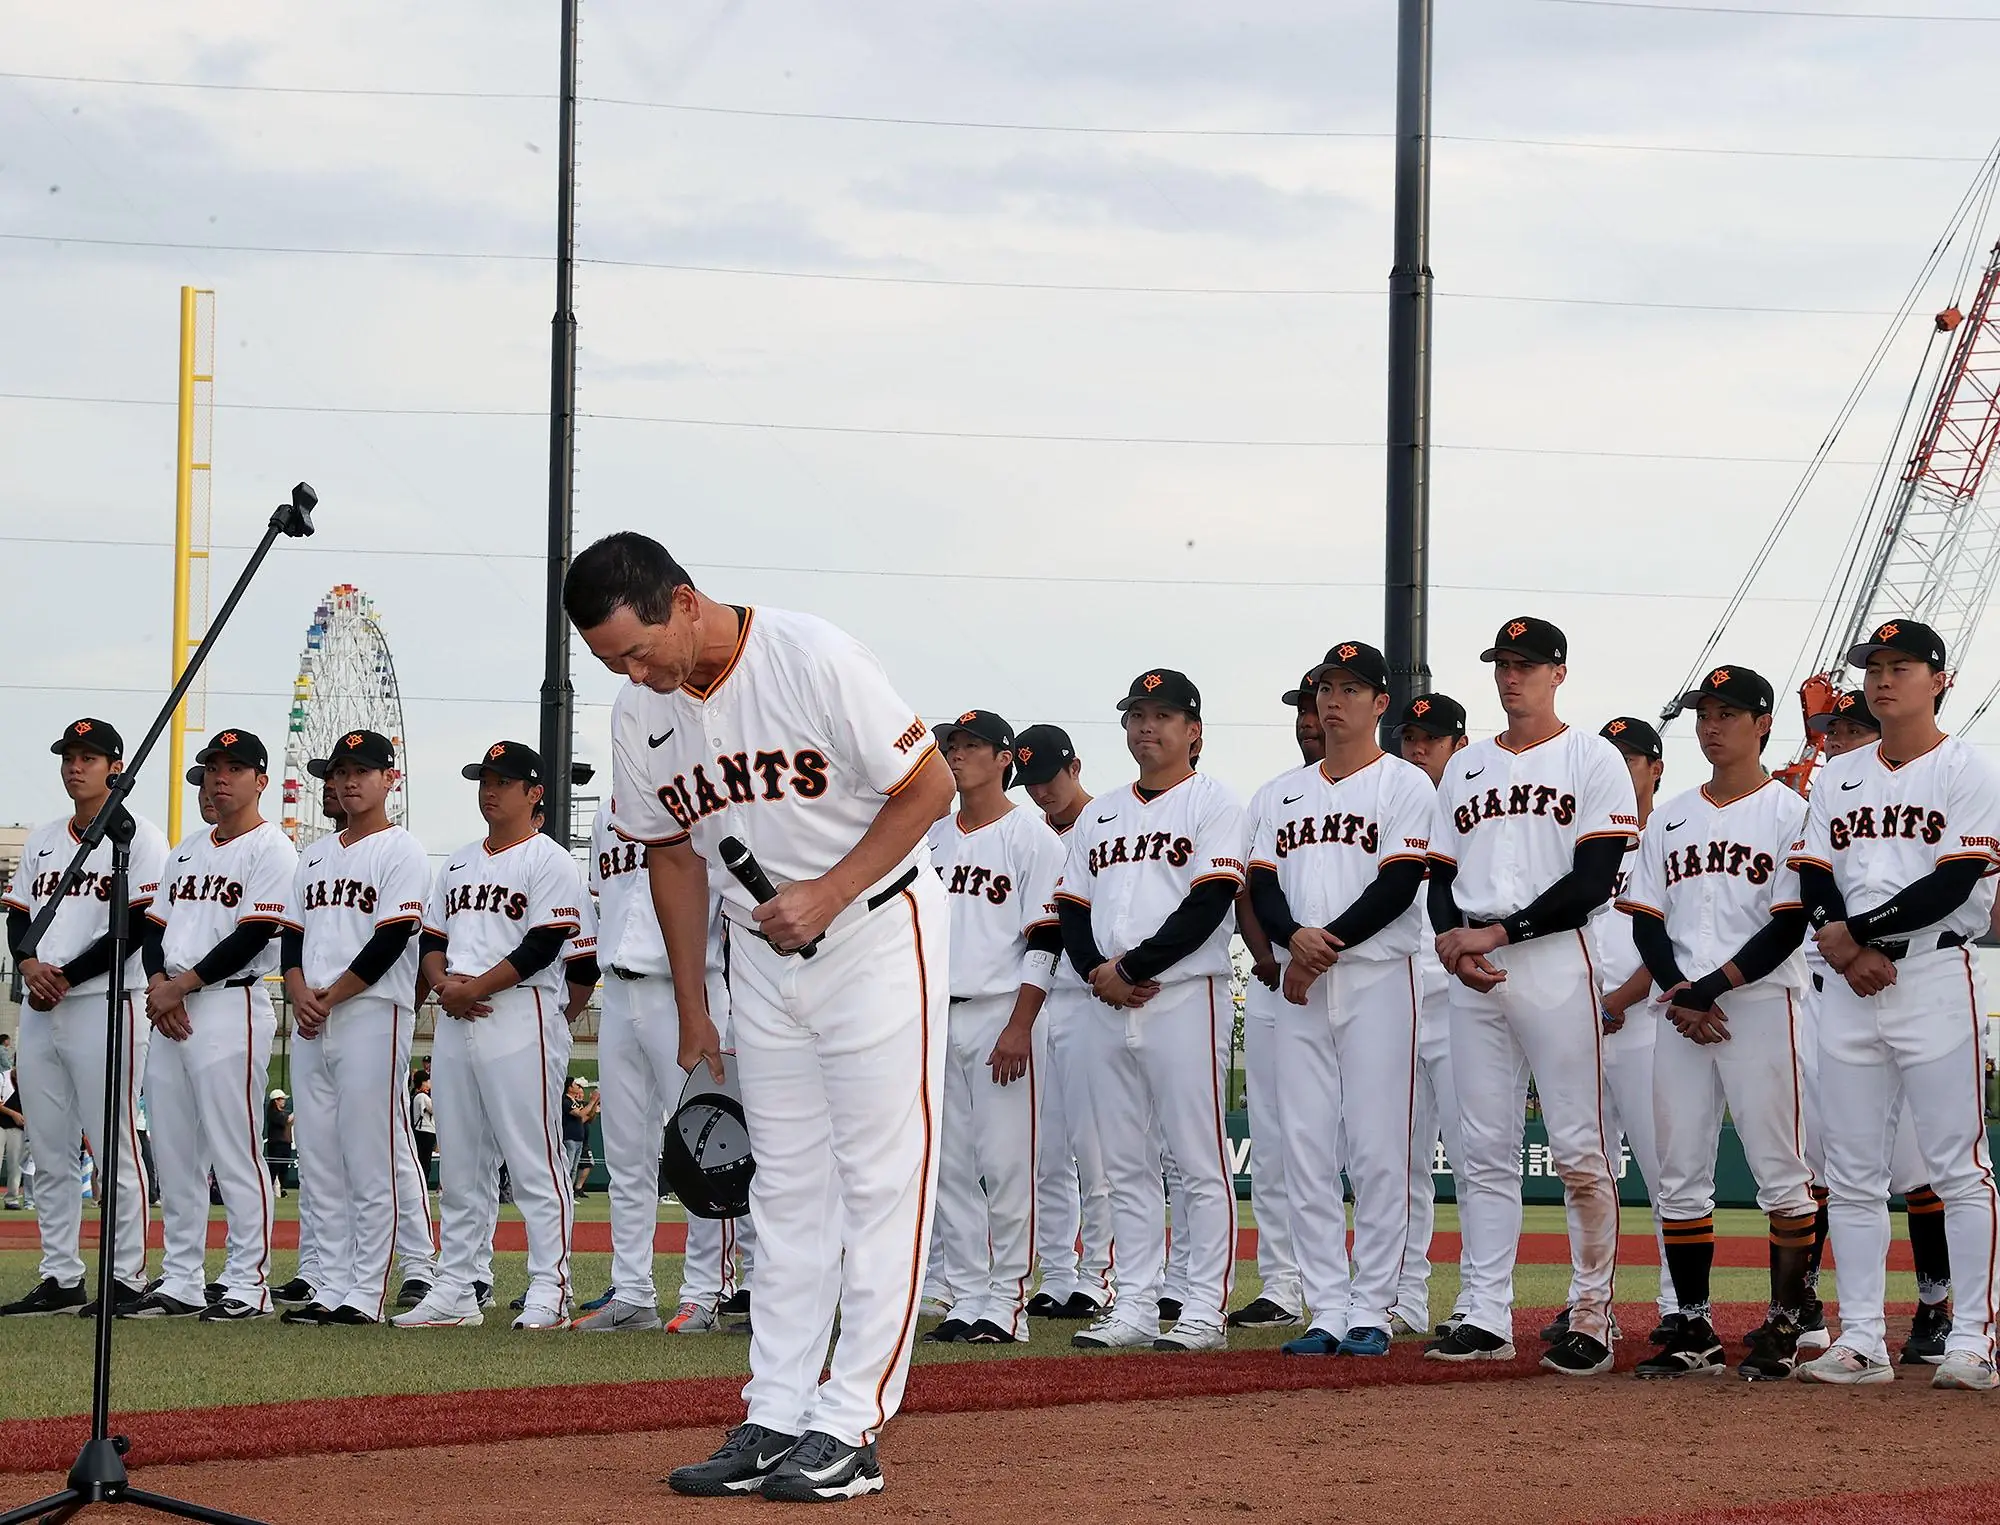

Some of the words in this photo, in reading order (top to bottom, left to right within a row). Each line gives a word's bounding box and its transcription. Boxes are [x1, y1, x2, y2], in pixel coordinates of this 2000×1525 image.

[656, 750, 829, 831] GIANTS
[1453, 783, 1577, 835] GIANTS
[1275, 812, 1379, 858] GIANTS
[1829, 803, 1947, 851] GIANTS
[1665, 840, 1775, 885] IANTS
